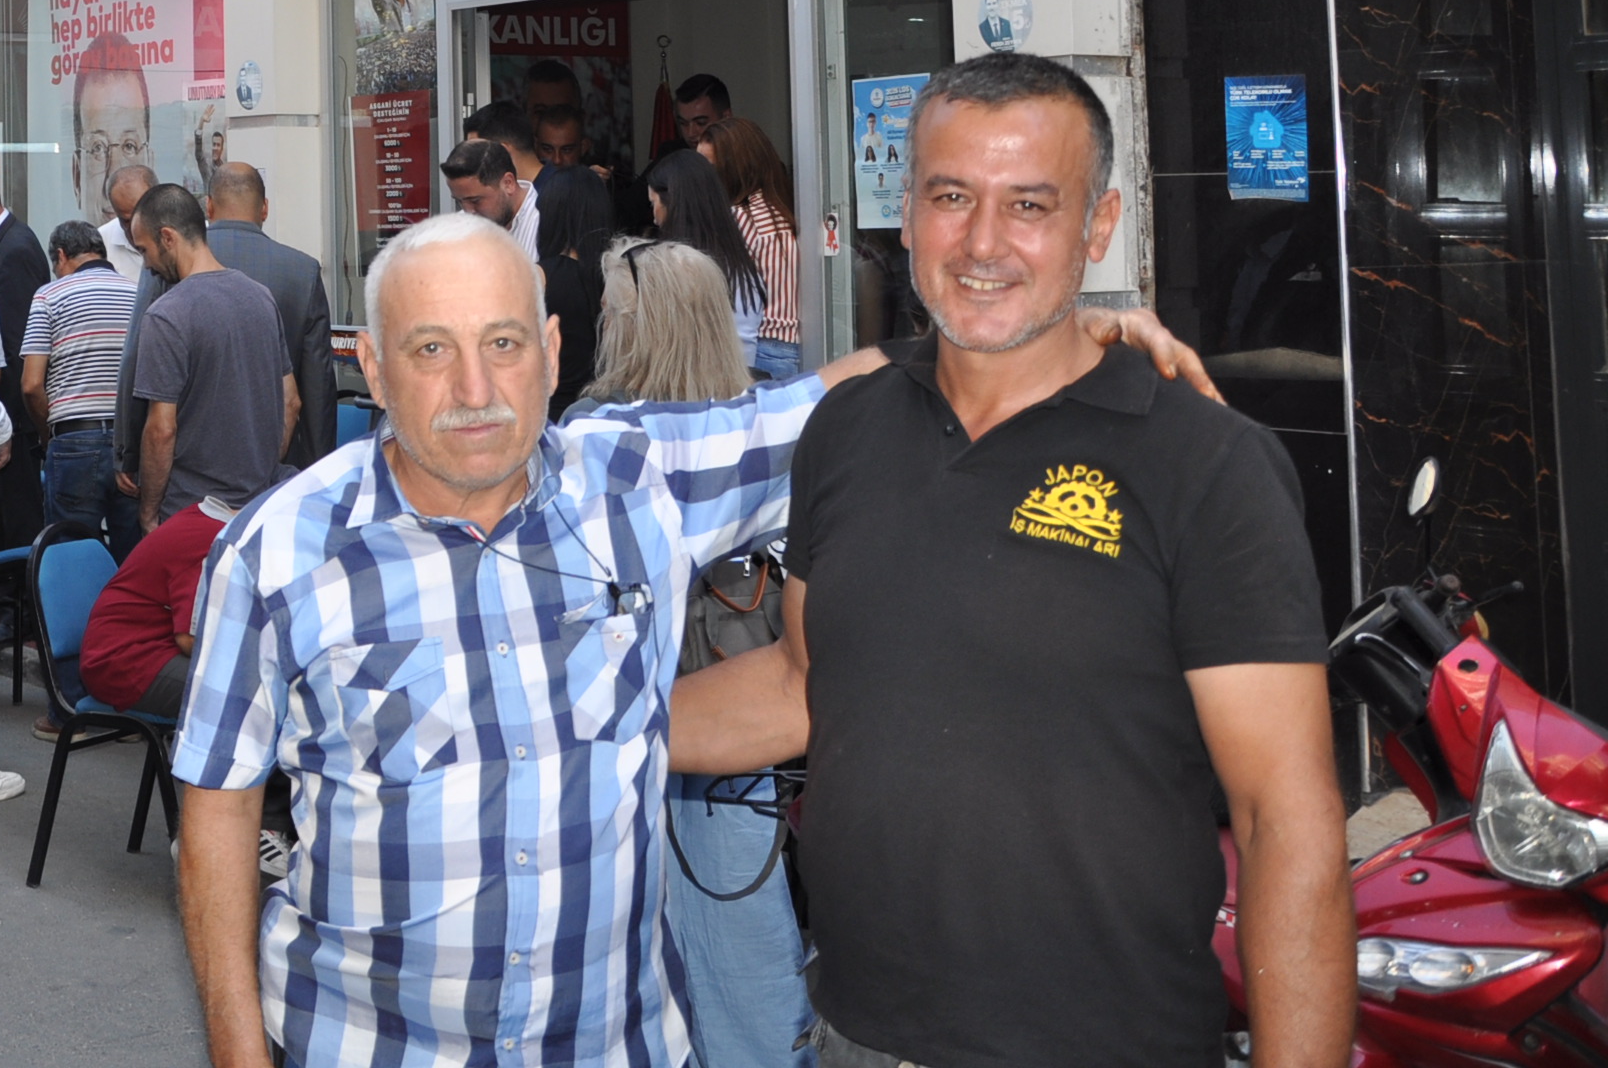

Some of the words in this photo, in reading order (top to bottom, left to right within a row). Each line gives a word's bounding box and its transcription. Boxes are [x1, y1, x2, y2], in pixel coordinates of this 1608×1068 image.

[51, 13, 82, 49] hep
[86, 1, 156, 39] birlikte
[369, 100, 392, 110] ASGARİ
[393, 99, 413, 108] ÜCRET
[1044, 464, 1119, 498] JAPON
